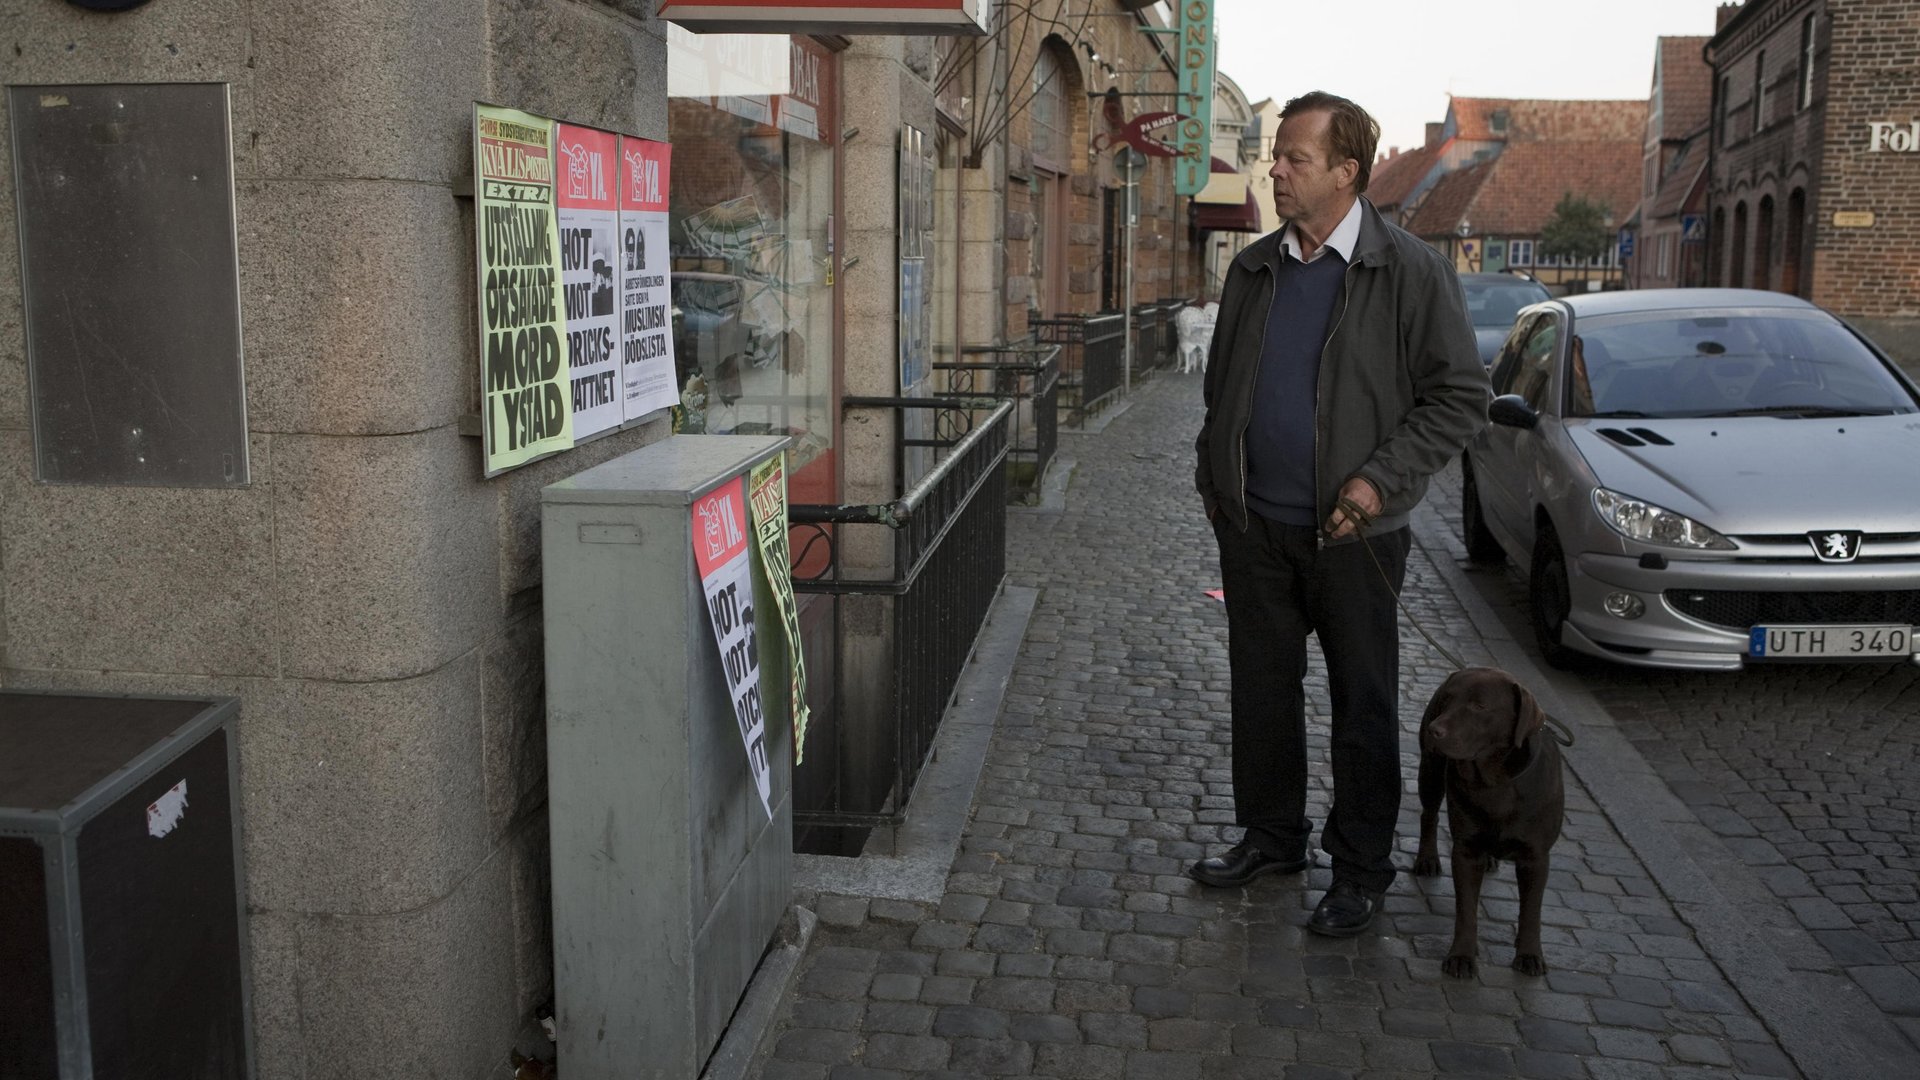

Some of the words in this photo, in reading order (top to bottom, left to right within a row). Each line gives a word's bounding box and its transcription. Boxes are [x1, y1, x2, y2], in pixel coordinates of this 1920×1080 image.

[481, 140, 550, 182] KVÄLLSPOSTEN
[486, 181, 549, 202] EXTRA
[484, 203, 553, 268] UTSTÄLLNING
[561, 227, 592, 272] HOT
[485, 268, 557, 331] ORSAKADE
[624, 304, 666, 335] MUSLIMSK
[488, 325, 561, 393] MORD
[624, 333, 667, 366] DÖDSLISTA
[488, 395, 496, 456] I
[502, 382, 565, 451] YSTAD
[710, 581, 740, 641] HOT
[1770, 630, 1826, 653] UTH
[1850, 630, 1905, 652] 340
